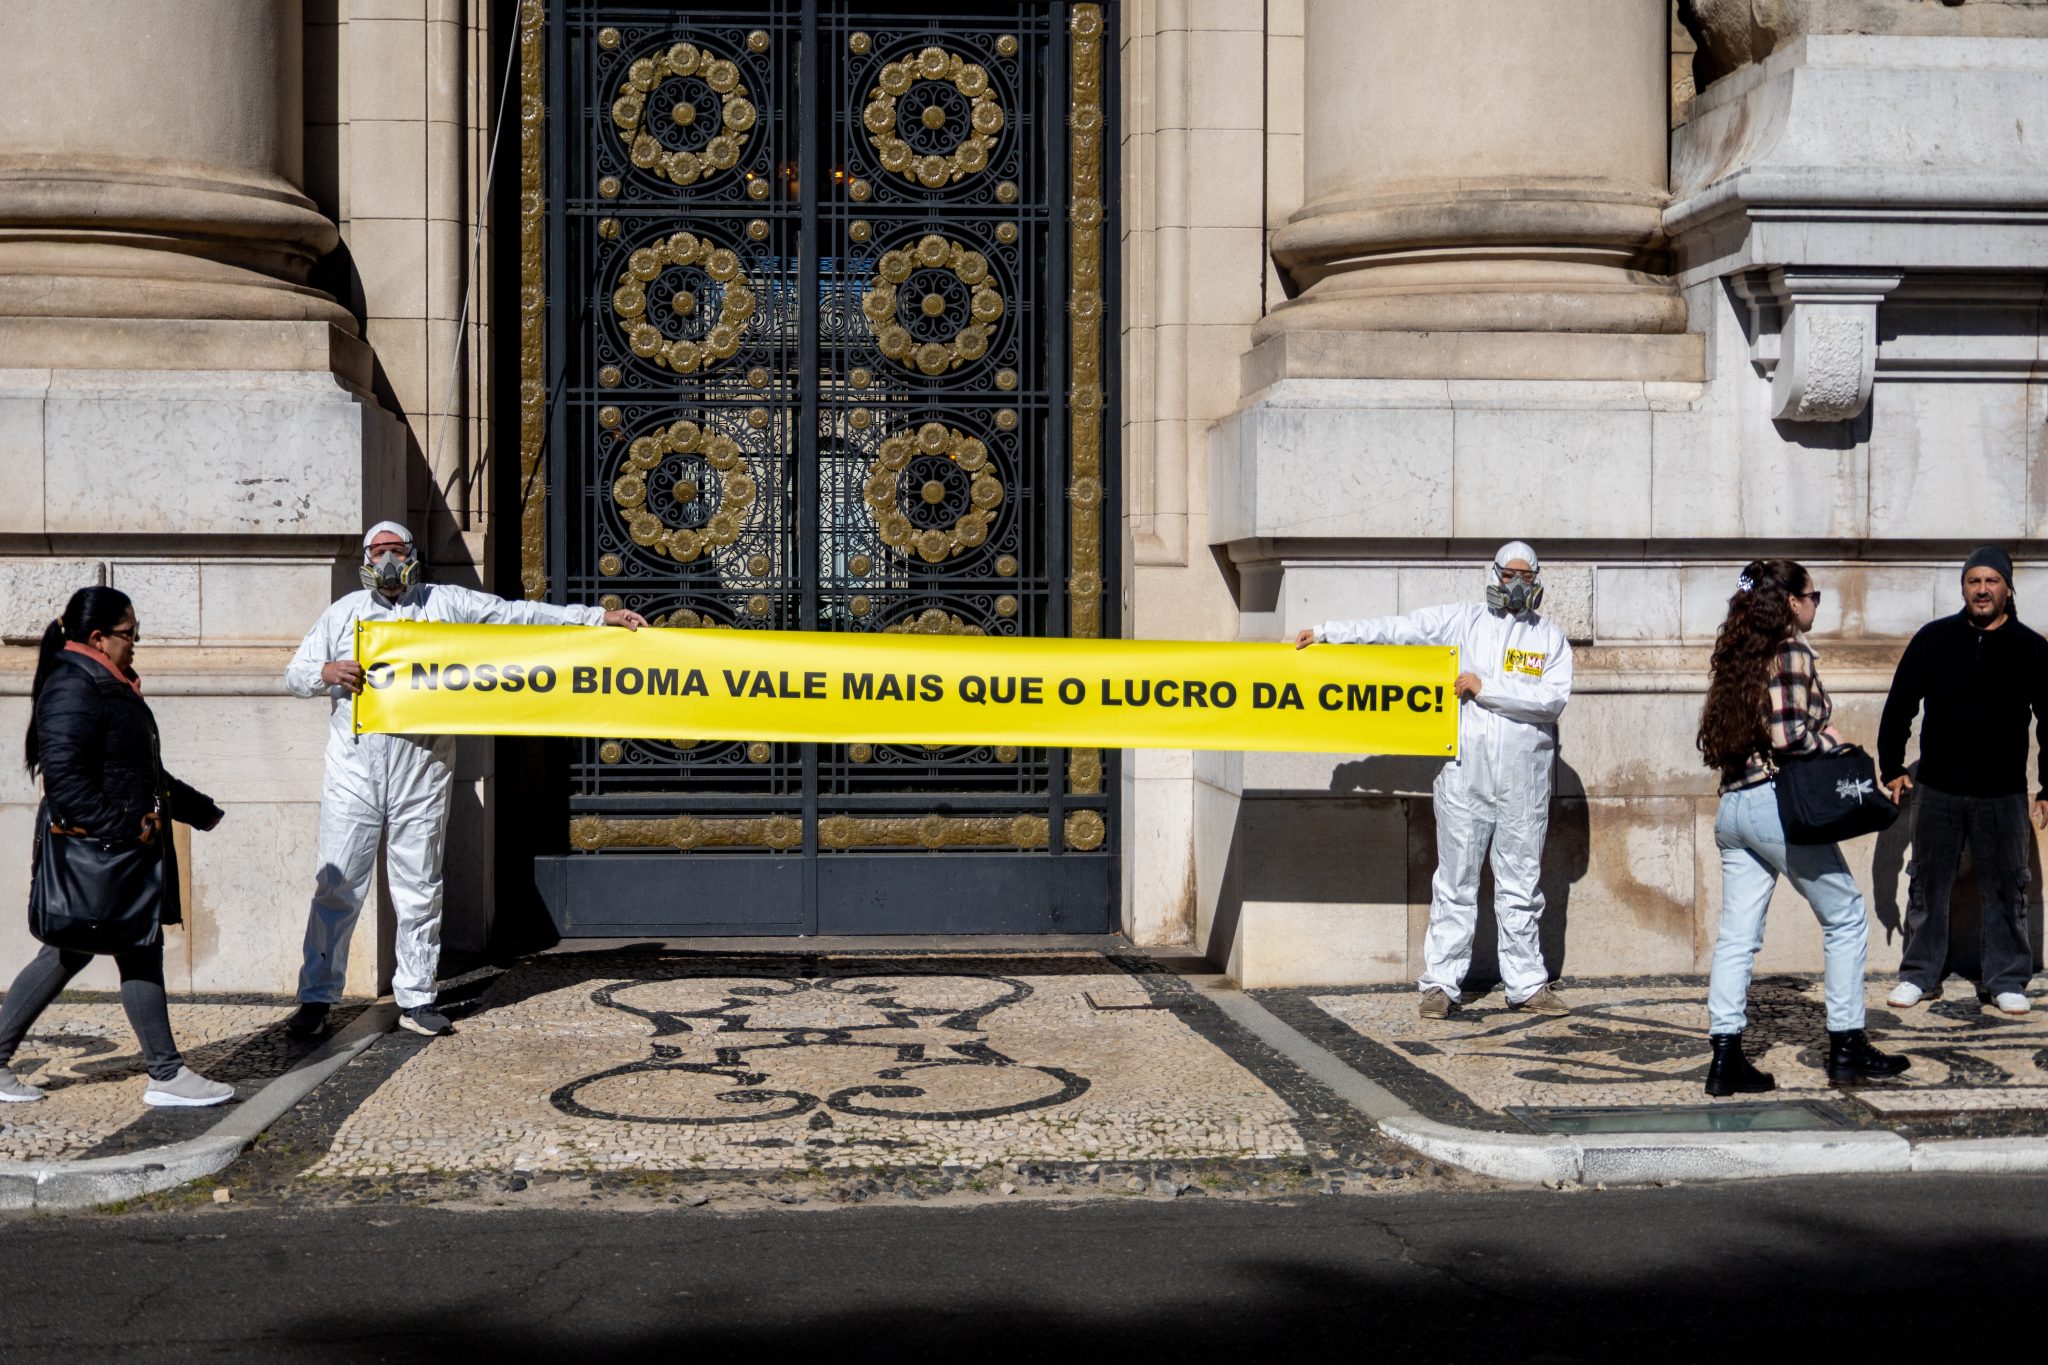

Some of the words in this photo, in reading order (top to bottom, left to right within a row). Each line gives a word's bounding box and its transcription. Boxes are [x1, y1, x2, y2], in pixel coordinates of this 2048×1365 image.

[367, 661, 395, 690] O
[410, 662, 557, 693] NOSSO
[572, 666, 710, 697] BIOMA
[722, 669, 827, 699] VALE
[842, 672, 944, 702] MAIS
[958, 675, 1044, 706] QUE
[1058, 677, 1086, 706] O
[1101, 678, 1237, 709] LUCRO
[1252, 682, 1305, 710] DA
[1318, 683, 1444, 713] CMPC!
